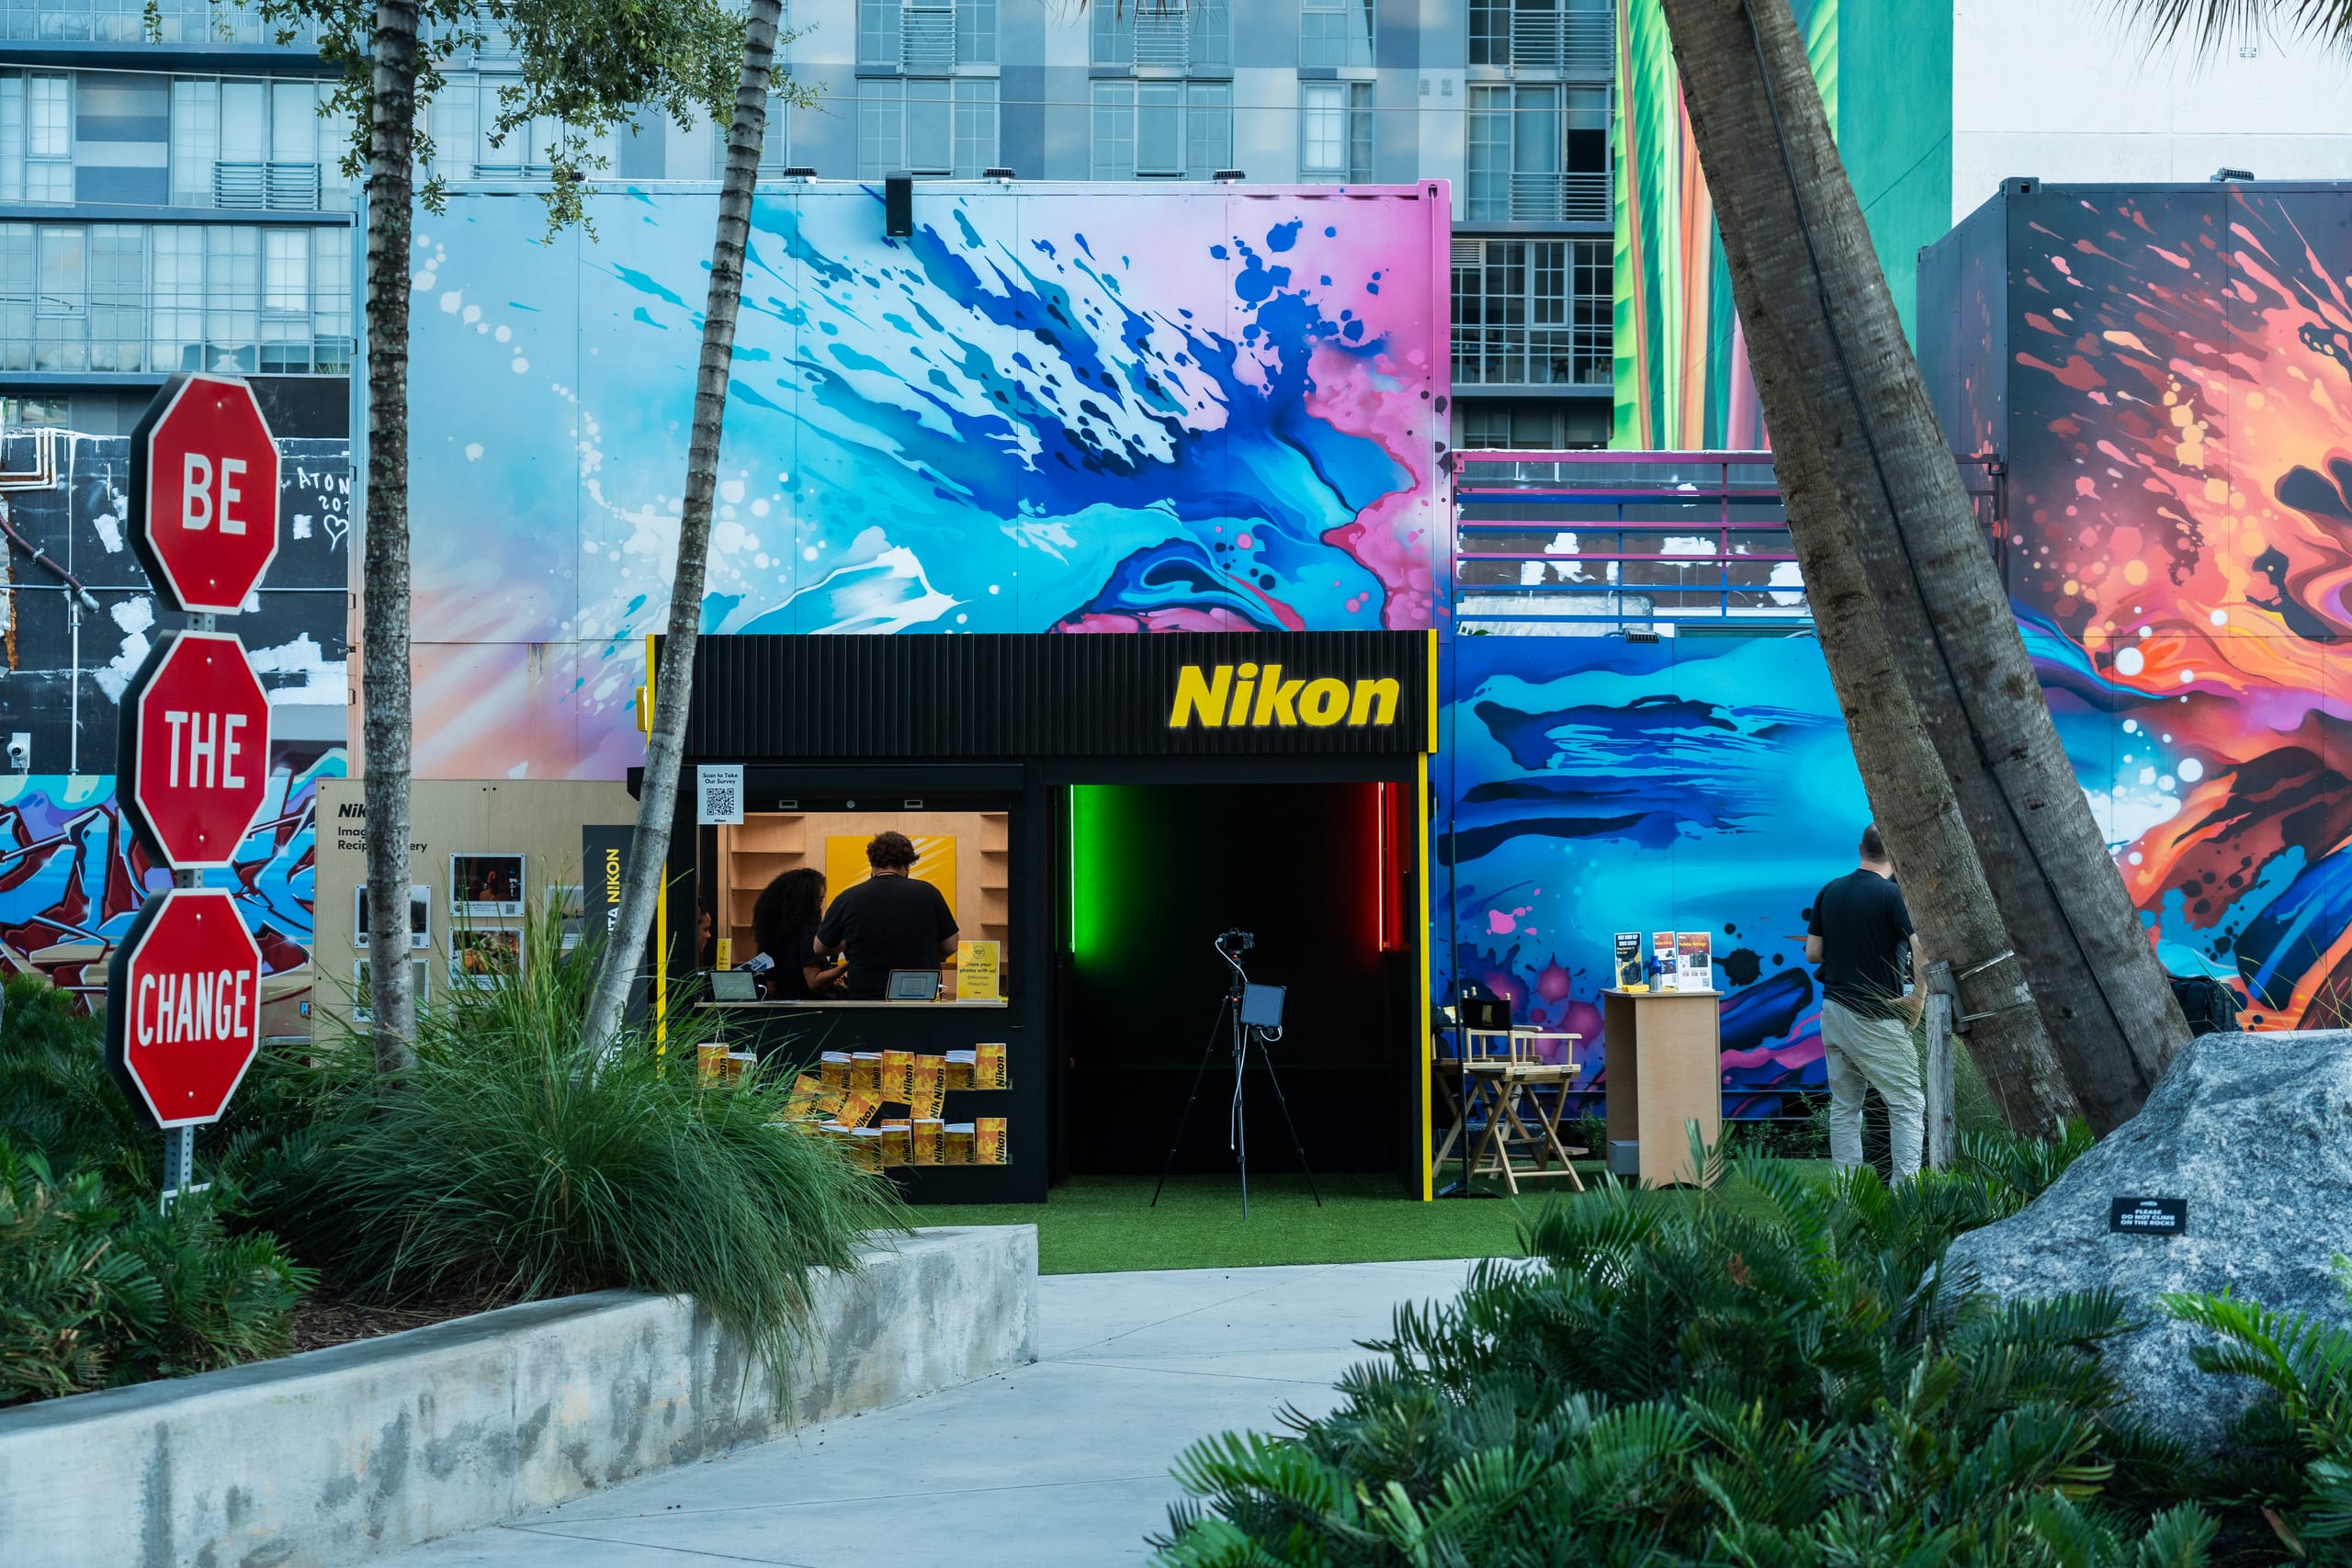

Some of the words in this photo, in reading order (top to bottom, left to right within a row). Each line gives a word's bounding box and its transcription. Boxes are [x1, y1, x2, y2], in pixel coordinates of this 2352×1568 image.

[182, 452, 248, 536] BE
[1170, 662, 1400, 728] Nikon
[164, 711, 246, 789] THE
[606, 848, 620, 903] NIKON
[137, 969, 251, 1047] CHANGE
[872, 1066, 881, 1089] Nikon
[903, 1064, 913, 1095] Nikon
[934, 1067, 944, 1100] Nikon
[995, 1055, 1005, 1088] Nikon
[903, 1138, 911, 1163] Nikon
[934, 1134, 944, 1164] Nikon
[966, 1140, 975, 1163] Nikon
[996, 1130, 1005, 1163] Nikon
